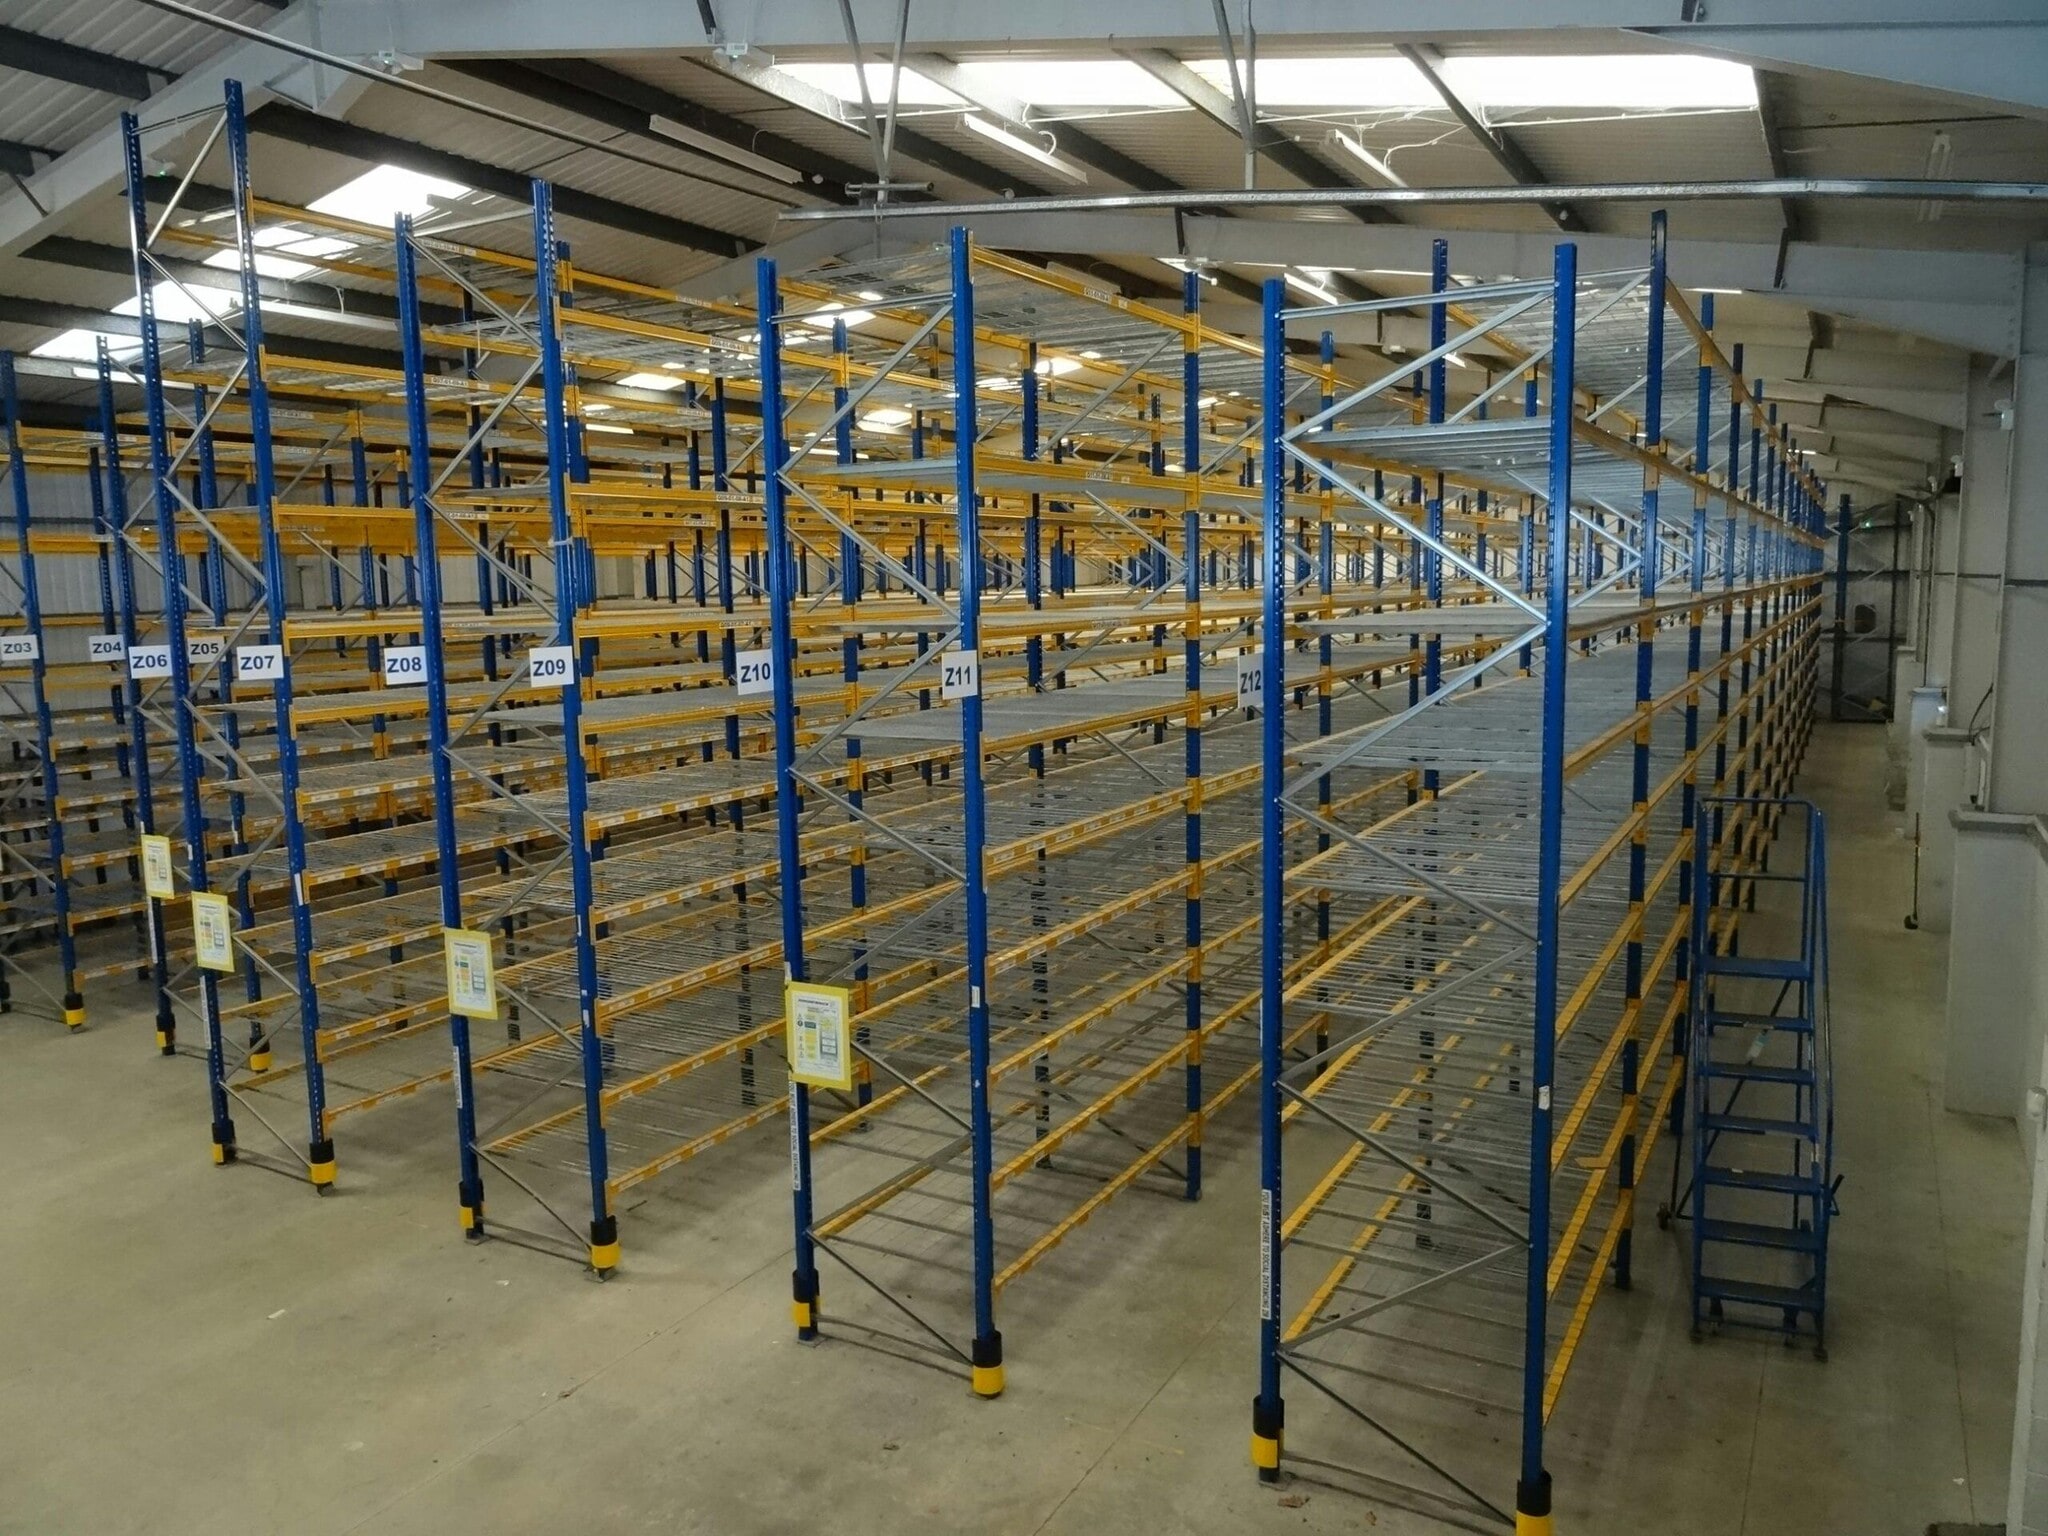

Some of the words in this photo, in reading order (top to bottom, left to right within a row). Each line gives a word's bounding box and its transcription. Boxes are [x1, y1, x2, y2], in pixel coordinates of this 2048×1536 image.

[3, 642, 32, 654] Z03
[92, 642, 121, 654] Z04
[190, 643, 219, 655] Z05
[132, 654, 168, 669] Z06
[240, 655, 275, 670] Z07
[387, 657, 422, 673] Z08
[533, 659, 566, 677] Z09
[740, 662, 771, 684] Z10
[945, 665, 971, 687] Z11
[1240, 669, 1262, 694] Z12
